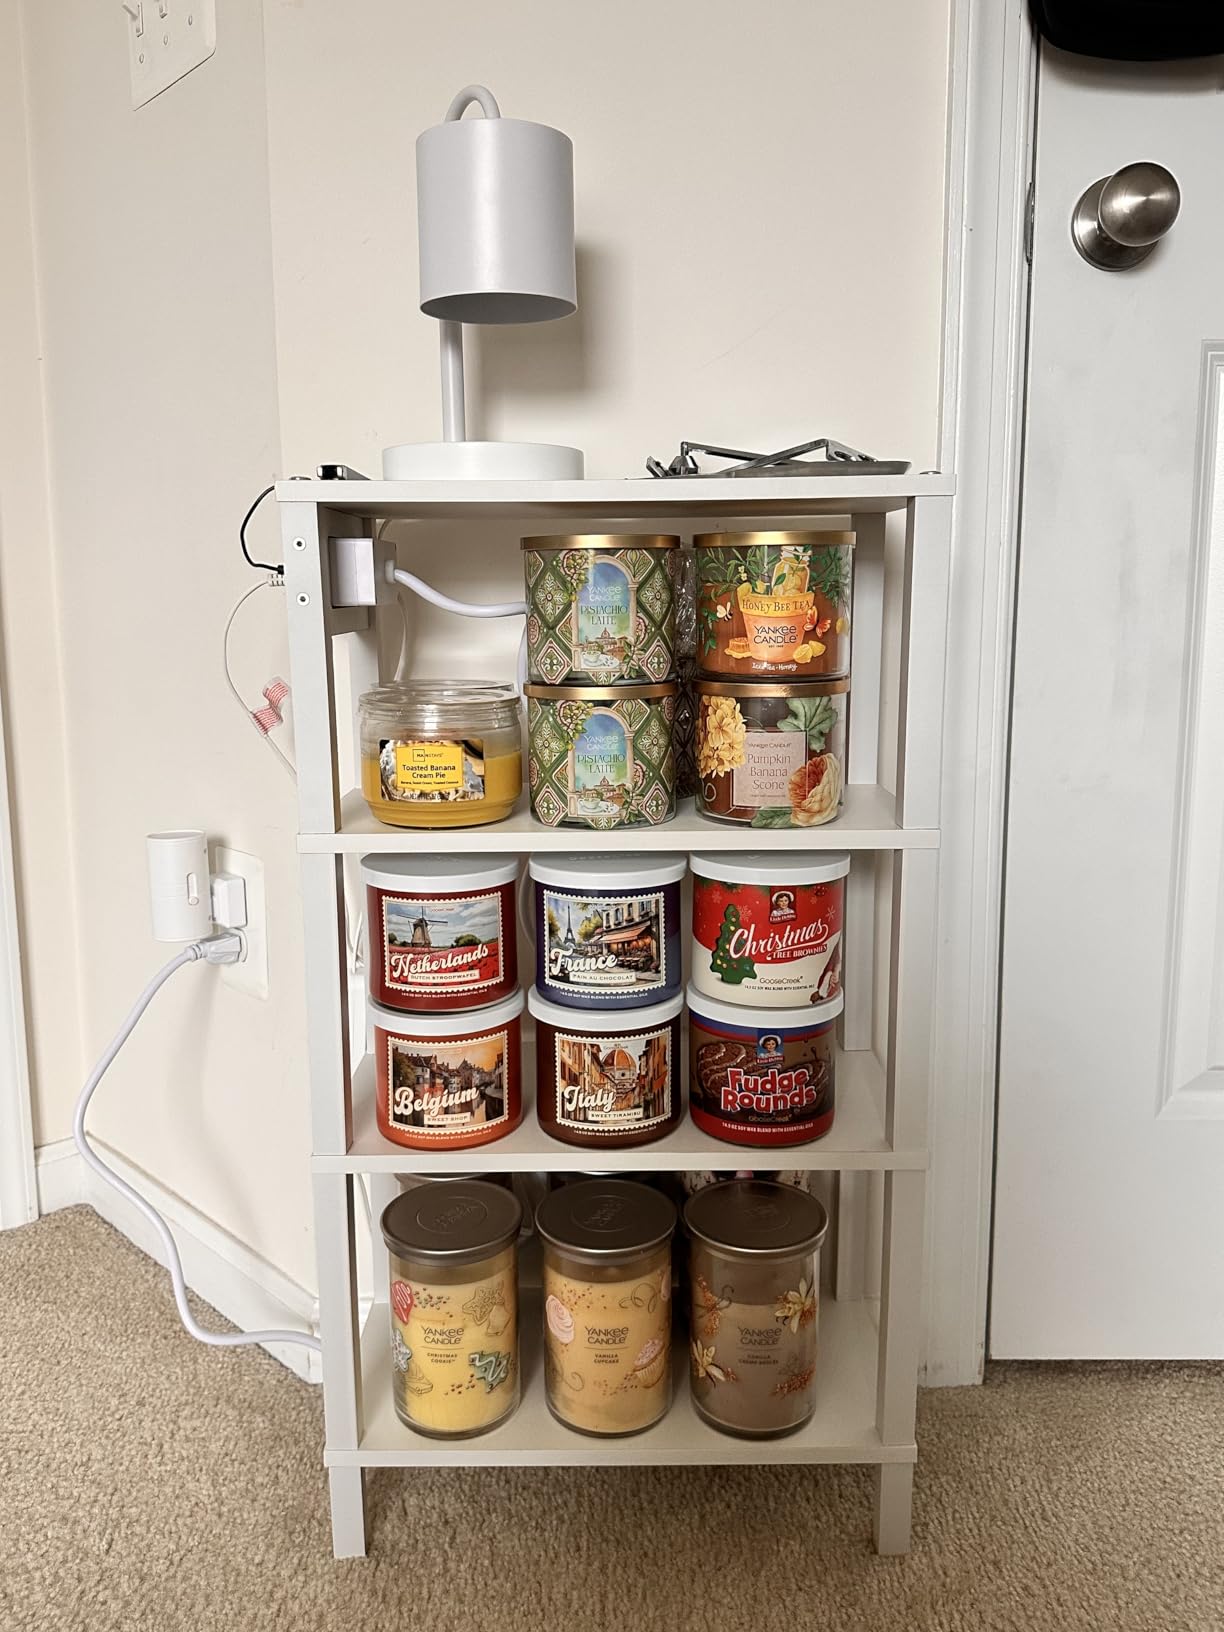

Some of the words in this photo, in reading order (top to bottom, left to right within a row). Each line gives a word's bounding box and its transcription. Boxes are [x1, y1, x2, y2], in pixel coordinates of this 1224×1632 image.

[580, 605, 627, 615] PISTACHIO
[742, 599, 772, 614] HONEY
[774, 601, 791, 612] BEE
[793, 600, 810, 612] TEA
[591, 616, 617, 625] LATTE
[754, 625, 797, 635] YANKEE
[753, 635, 798, 644] CANDLE
[577, 754, 625, 764] PISTACHIO
[747, 754, 791, 765] Pumpkin
[589, 764, 616, 774] LATTE
[750, 767, 788, 777] Banana
[753, 779, 785, 790] Scone
[730, 918, 828, 959] Christmas
[773, 951, 791, 959] TREE
[793, 944, 827, 958] BROWNIES
[390, 943, 489, 978] Netherlands
[550, 947, 618, 976] France
[432, 972, 477, 980] STROOPWAFEL
[728, 1068, 809, 1095] Fudge
[394, 1086, 480, 1117] Belgium
[563, 1085, 617, 1113] Italy
[721, 1084, 817, 1113] Rounds
[421, 1325, 464, 1338] YANKEE
[585, 1325, 629, 1338] YANKEE
[424, 1336, 462, 1345] CANDLE
[587, 1336, 627, 1345] CANDLE
